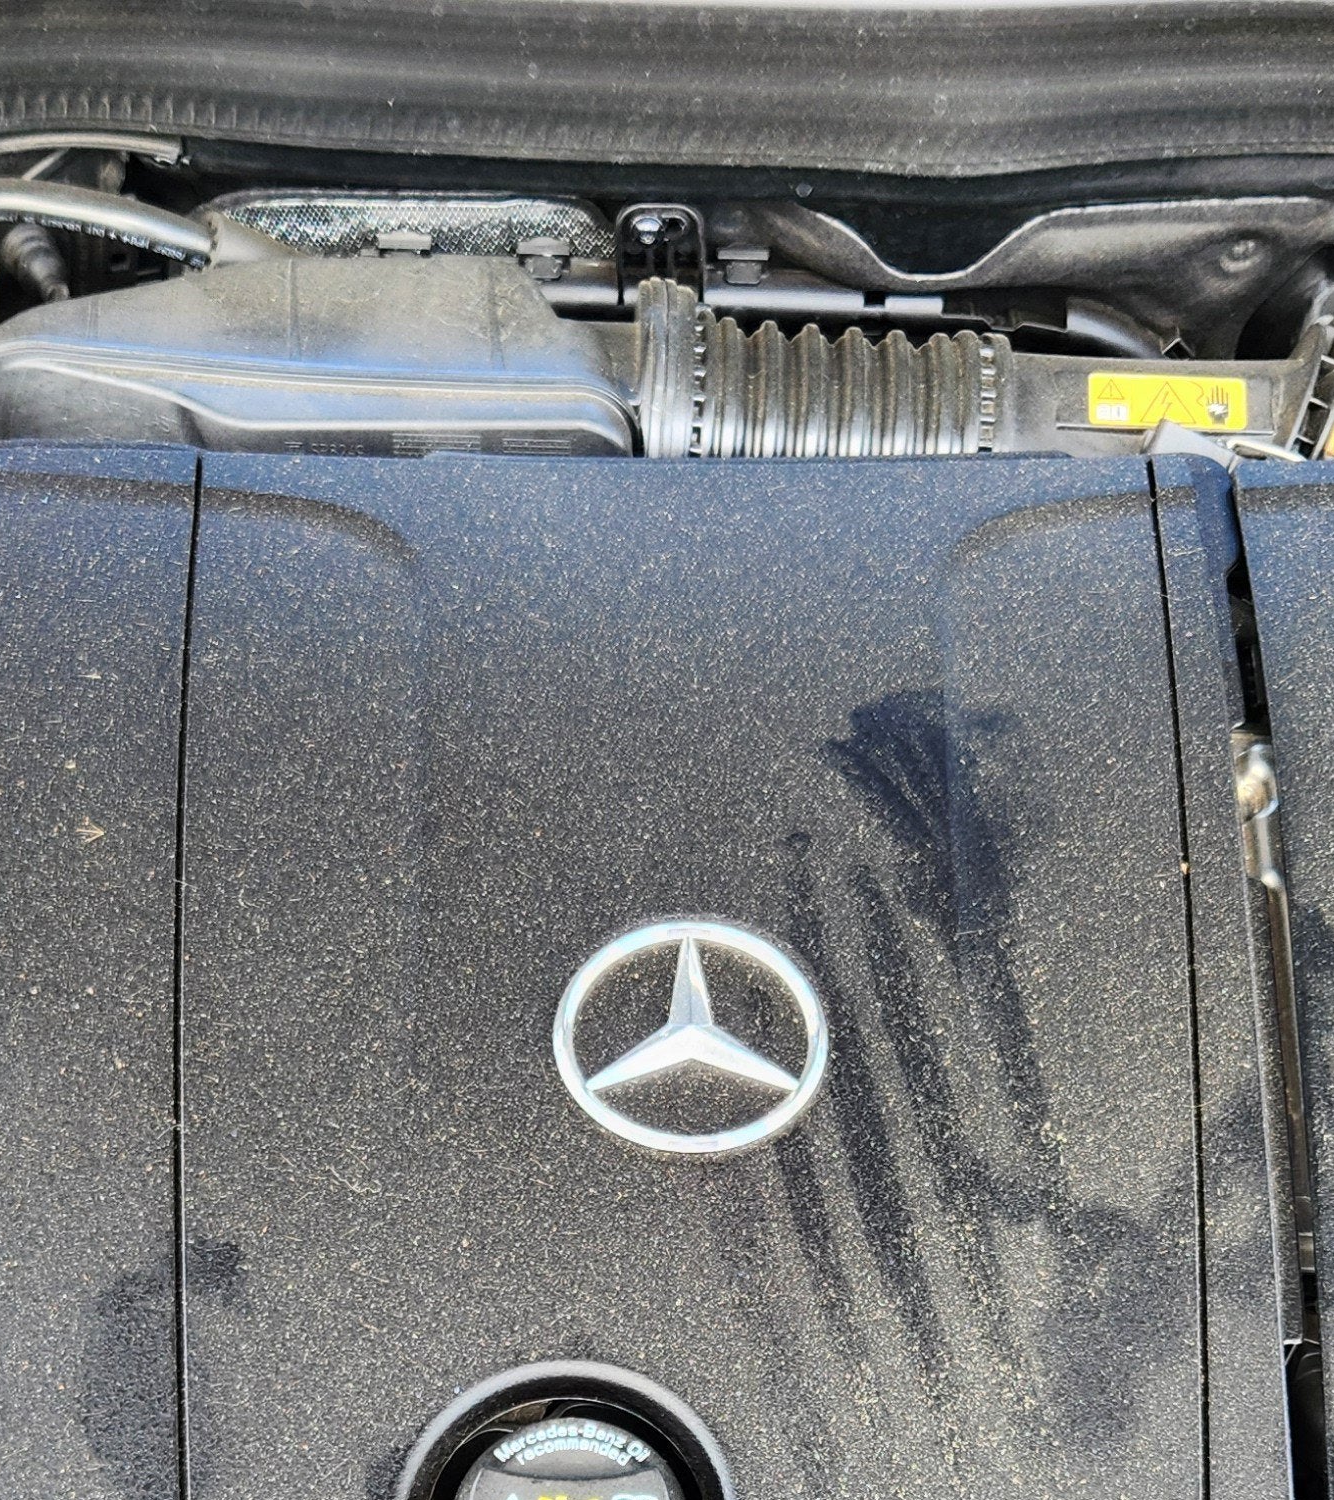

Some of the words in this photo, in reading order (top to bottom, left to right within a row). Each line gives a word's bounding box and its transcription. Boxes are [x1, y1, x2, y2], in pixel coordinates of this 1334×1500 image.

[493, 1423, 627, 1462] Mercedes-Benz
[626, 1440, 651, 1463] Oil
[515, 1437, 632, 1466] recommended
